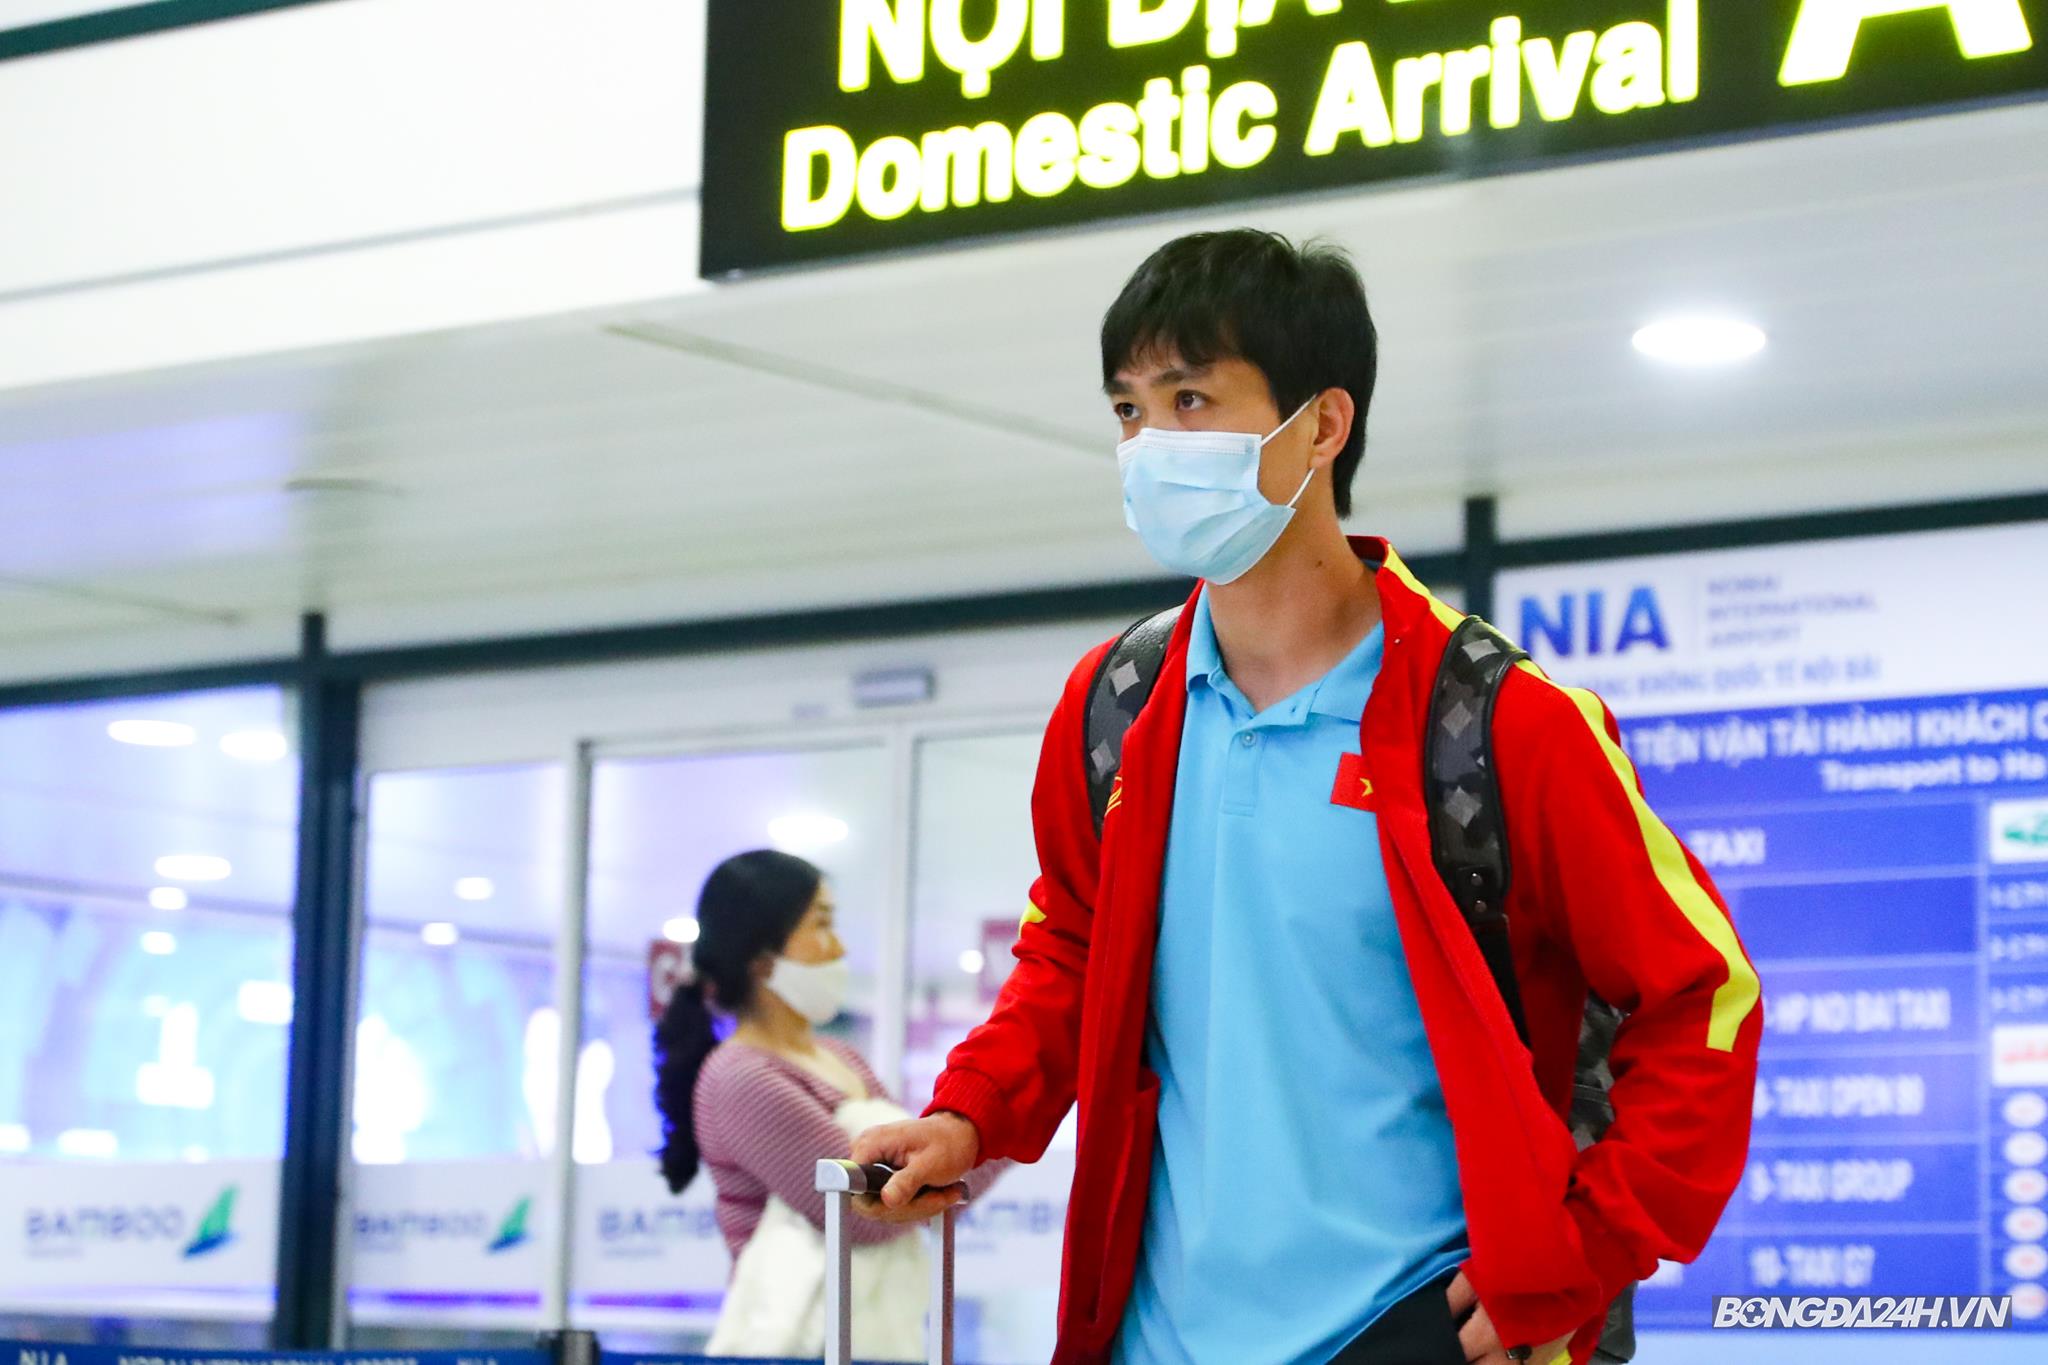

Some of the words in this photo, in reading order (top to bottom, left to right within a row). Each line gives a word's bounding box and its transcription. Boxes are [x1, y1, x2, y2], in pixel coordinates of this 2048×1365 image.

[781, 63, 1278, 232] Domestic
[1303, 0, 1699, 156] Arrival
[1520, 586, 1670, 657] NIA
[1687, 829, 1765, 868] TAXI
